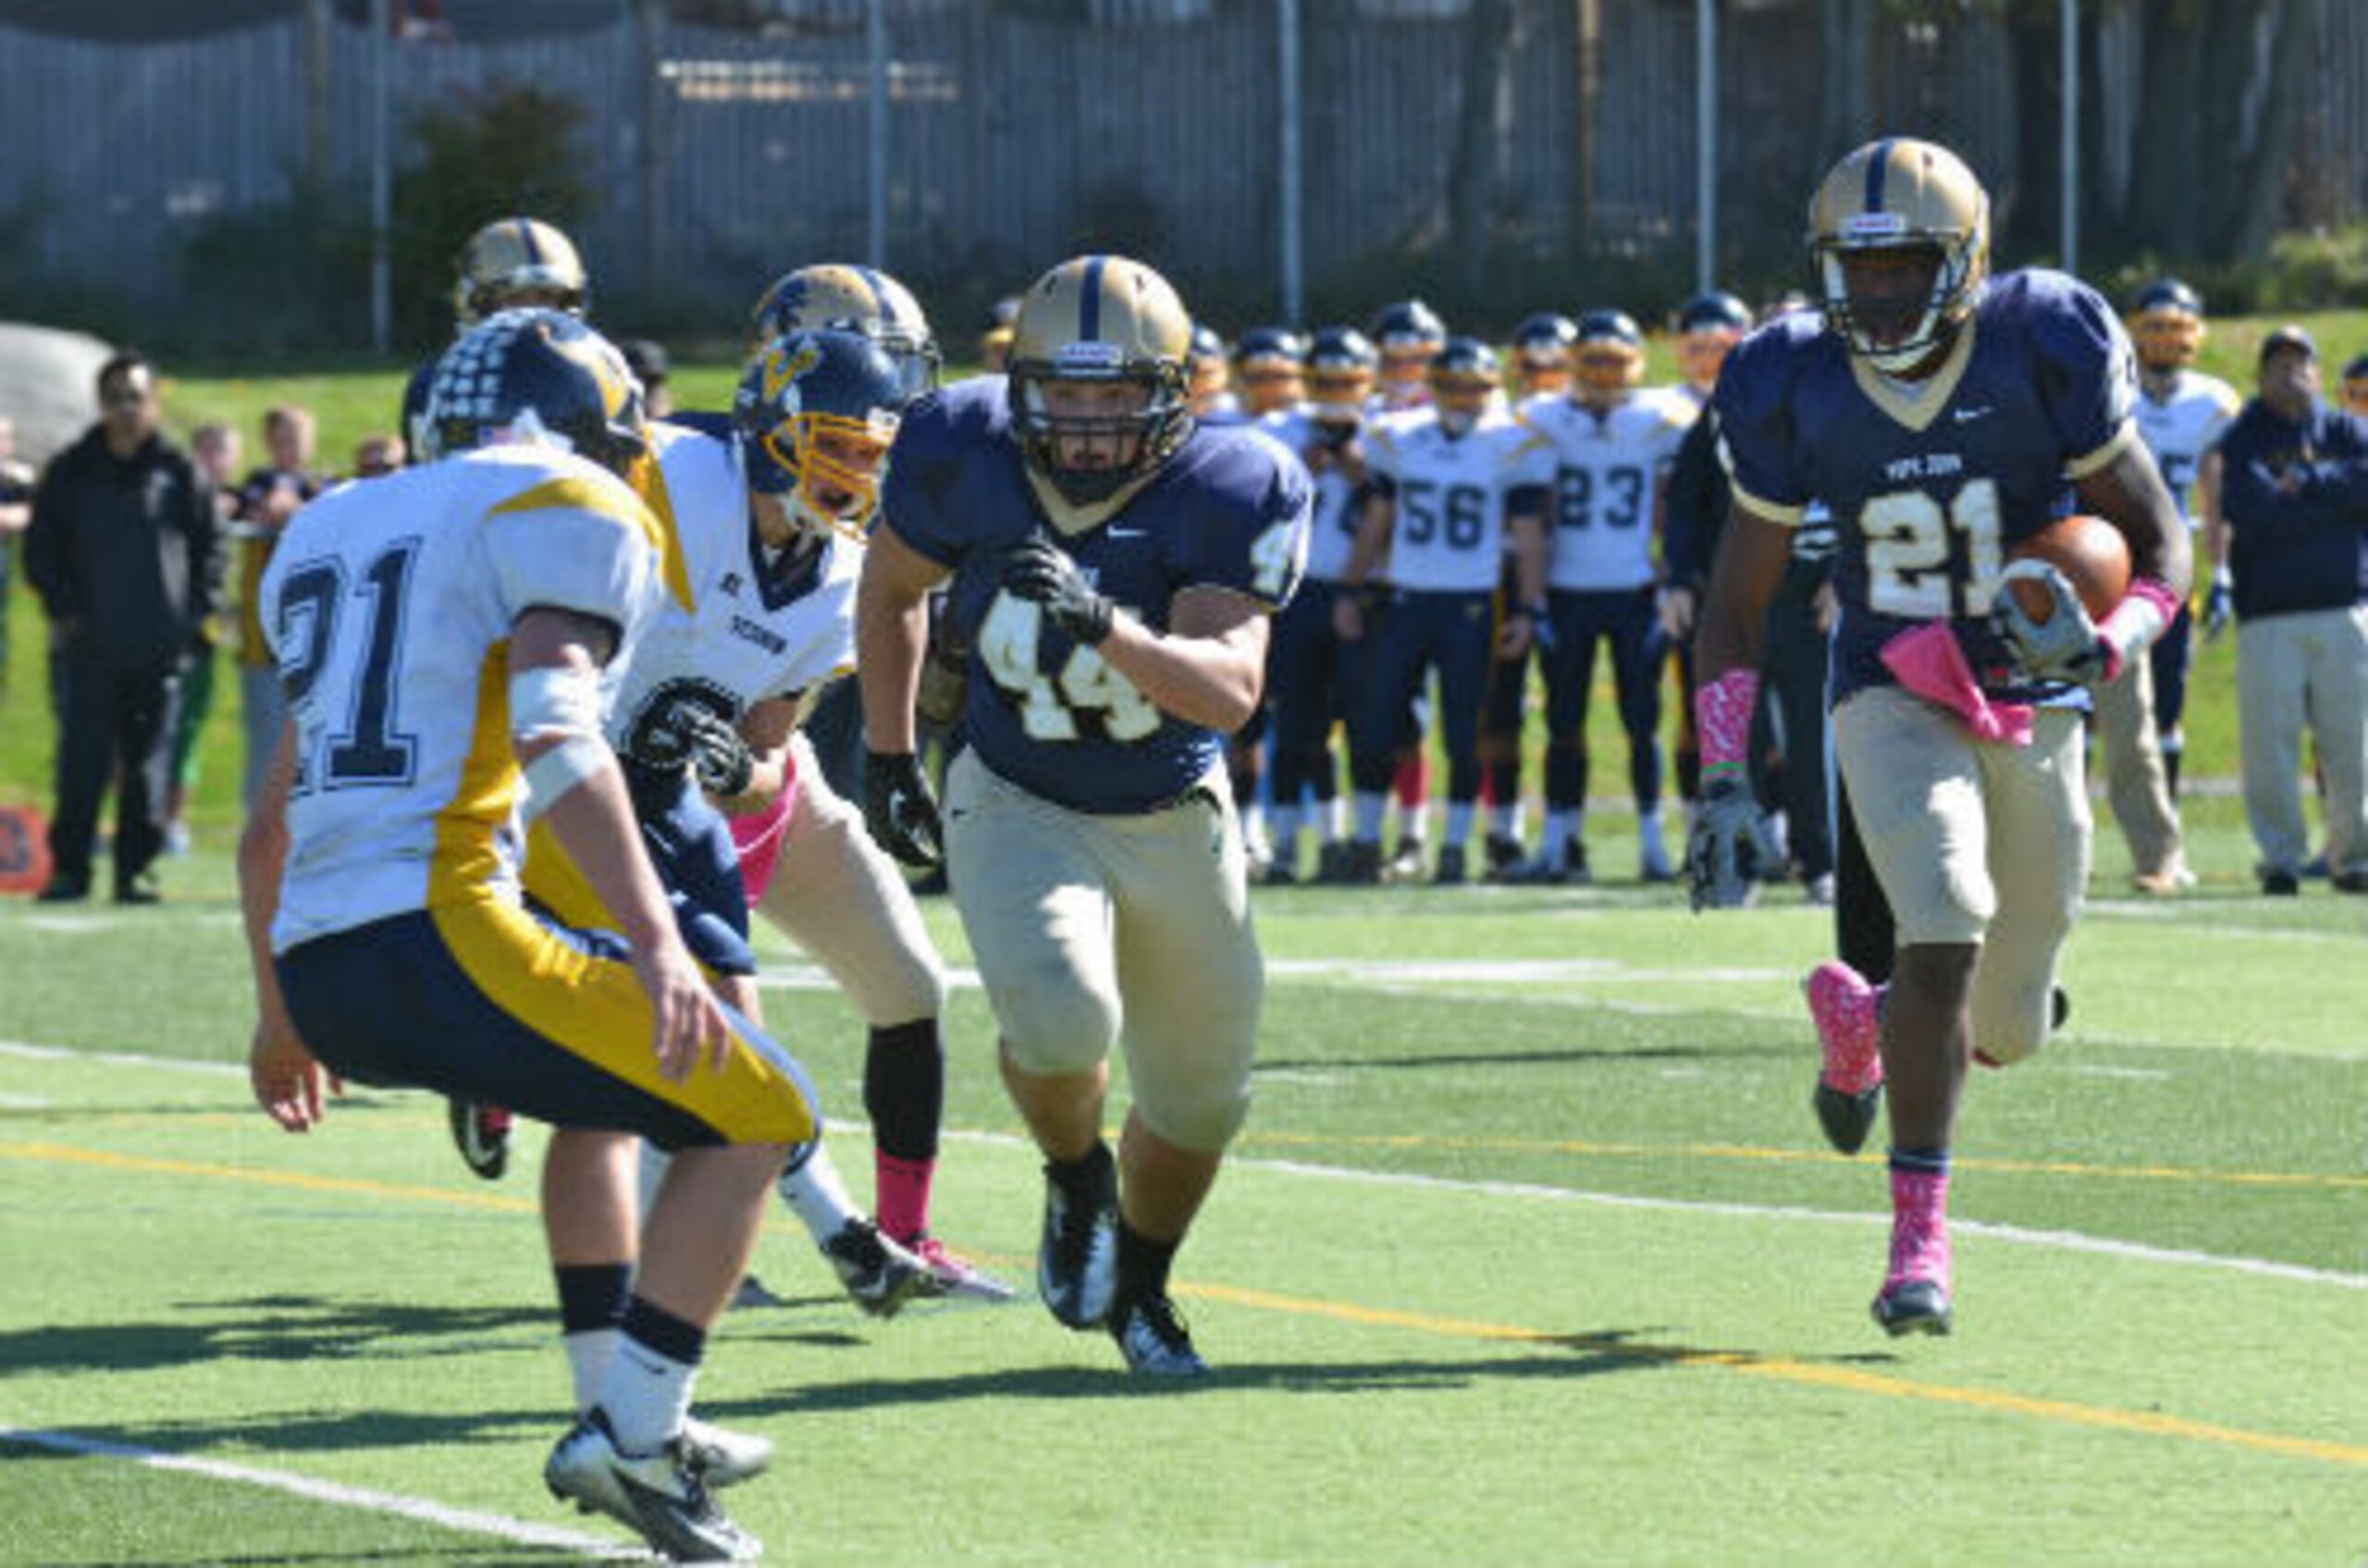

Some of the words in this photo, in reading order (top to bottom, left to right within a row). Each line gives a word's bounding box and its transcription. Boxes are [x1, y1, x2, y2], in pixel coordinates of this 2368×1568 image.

[1400, 479, 1485, 549] 56
[1556, 464, 1644, 530] 23
[1861, 478, 2002, 618] 21
[279, 535, 423, 799] 21
[979, 586, 1162, 741] 44
